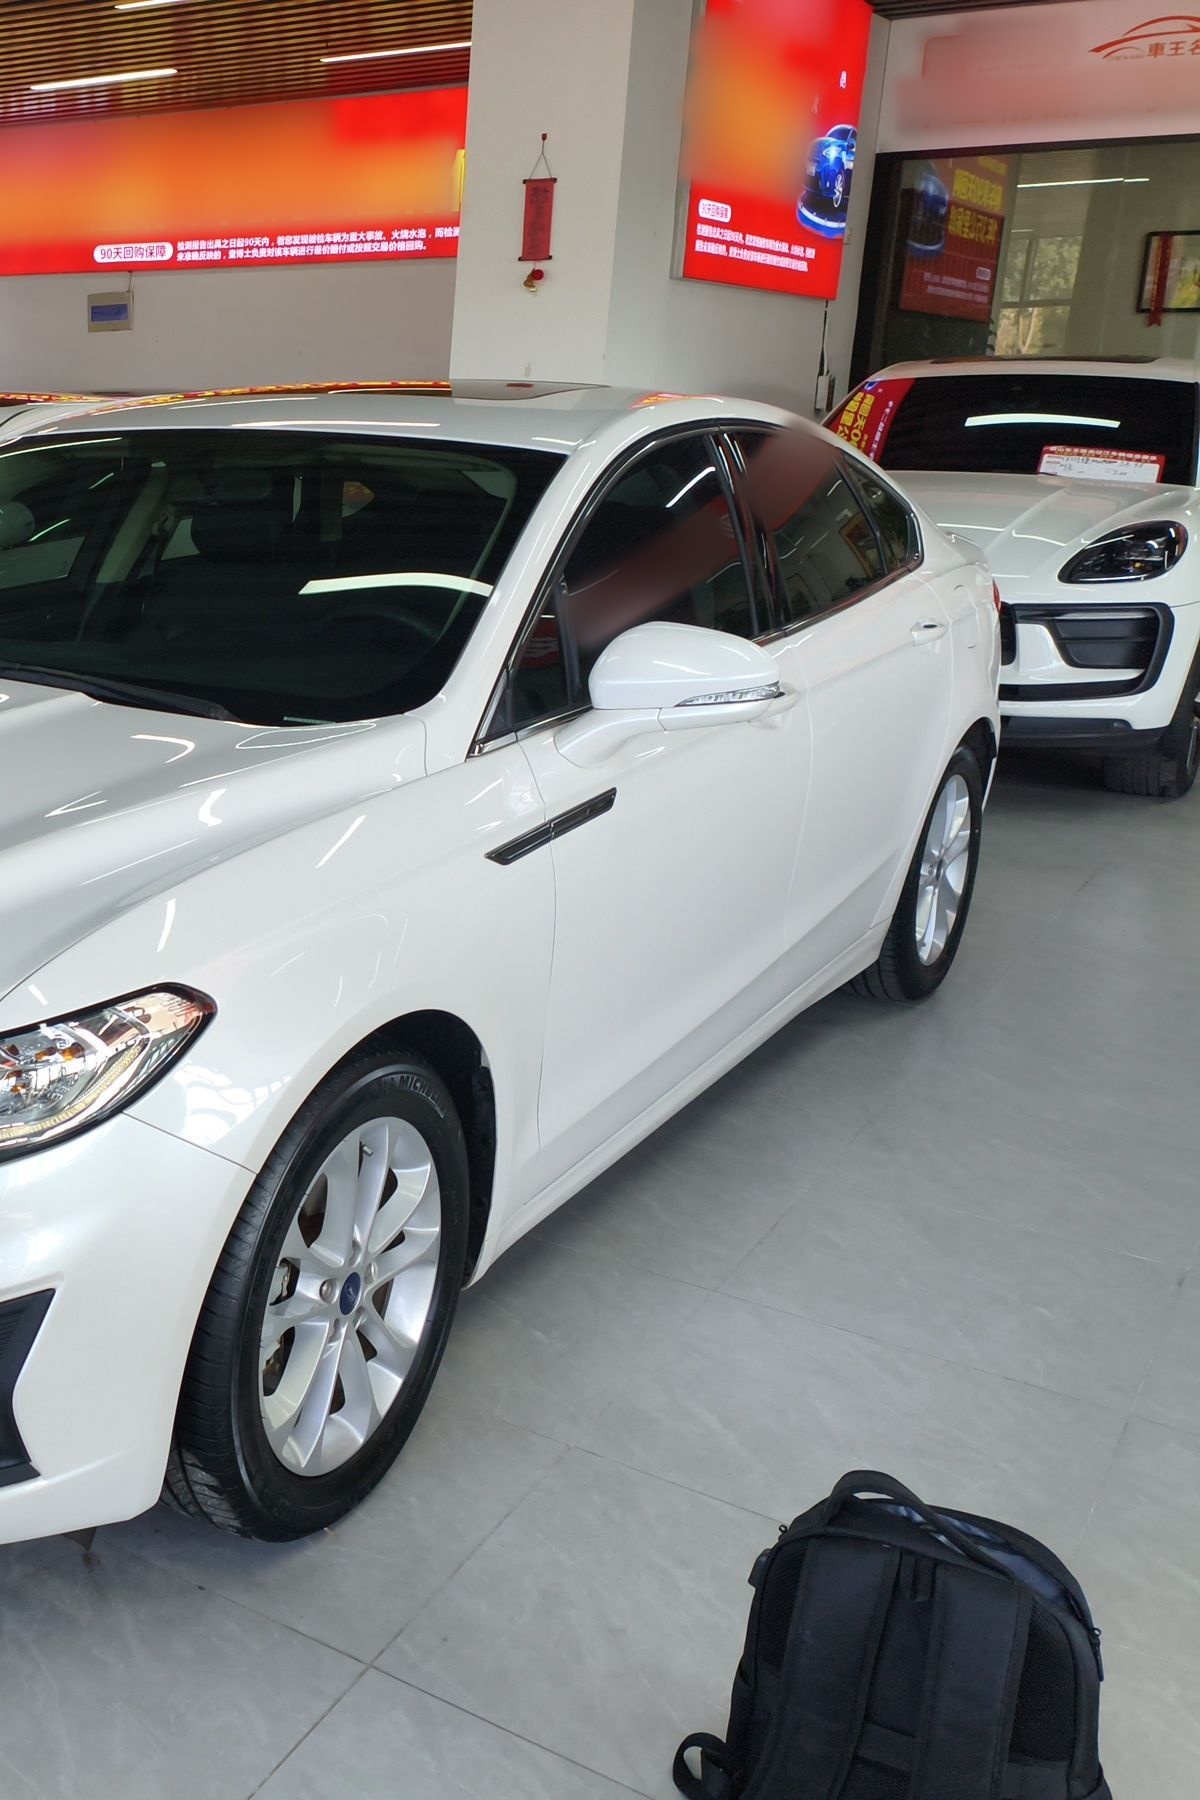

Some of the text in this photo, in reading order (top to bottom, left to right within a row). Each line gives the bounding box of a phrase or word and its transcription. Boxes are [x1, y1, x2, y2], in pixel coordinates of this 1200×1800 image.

[100, 245, 167, 260] 90天回购保障
